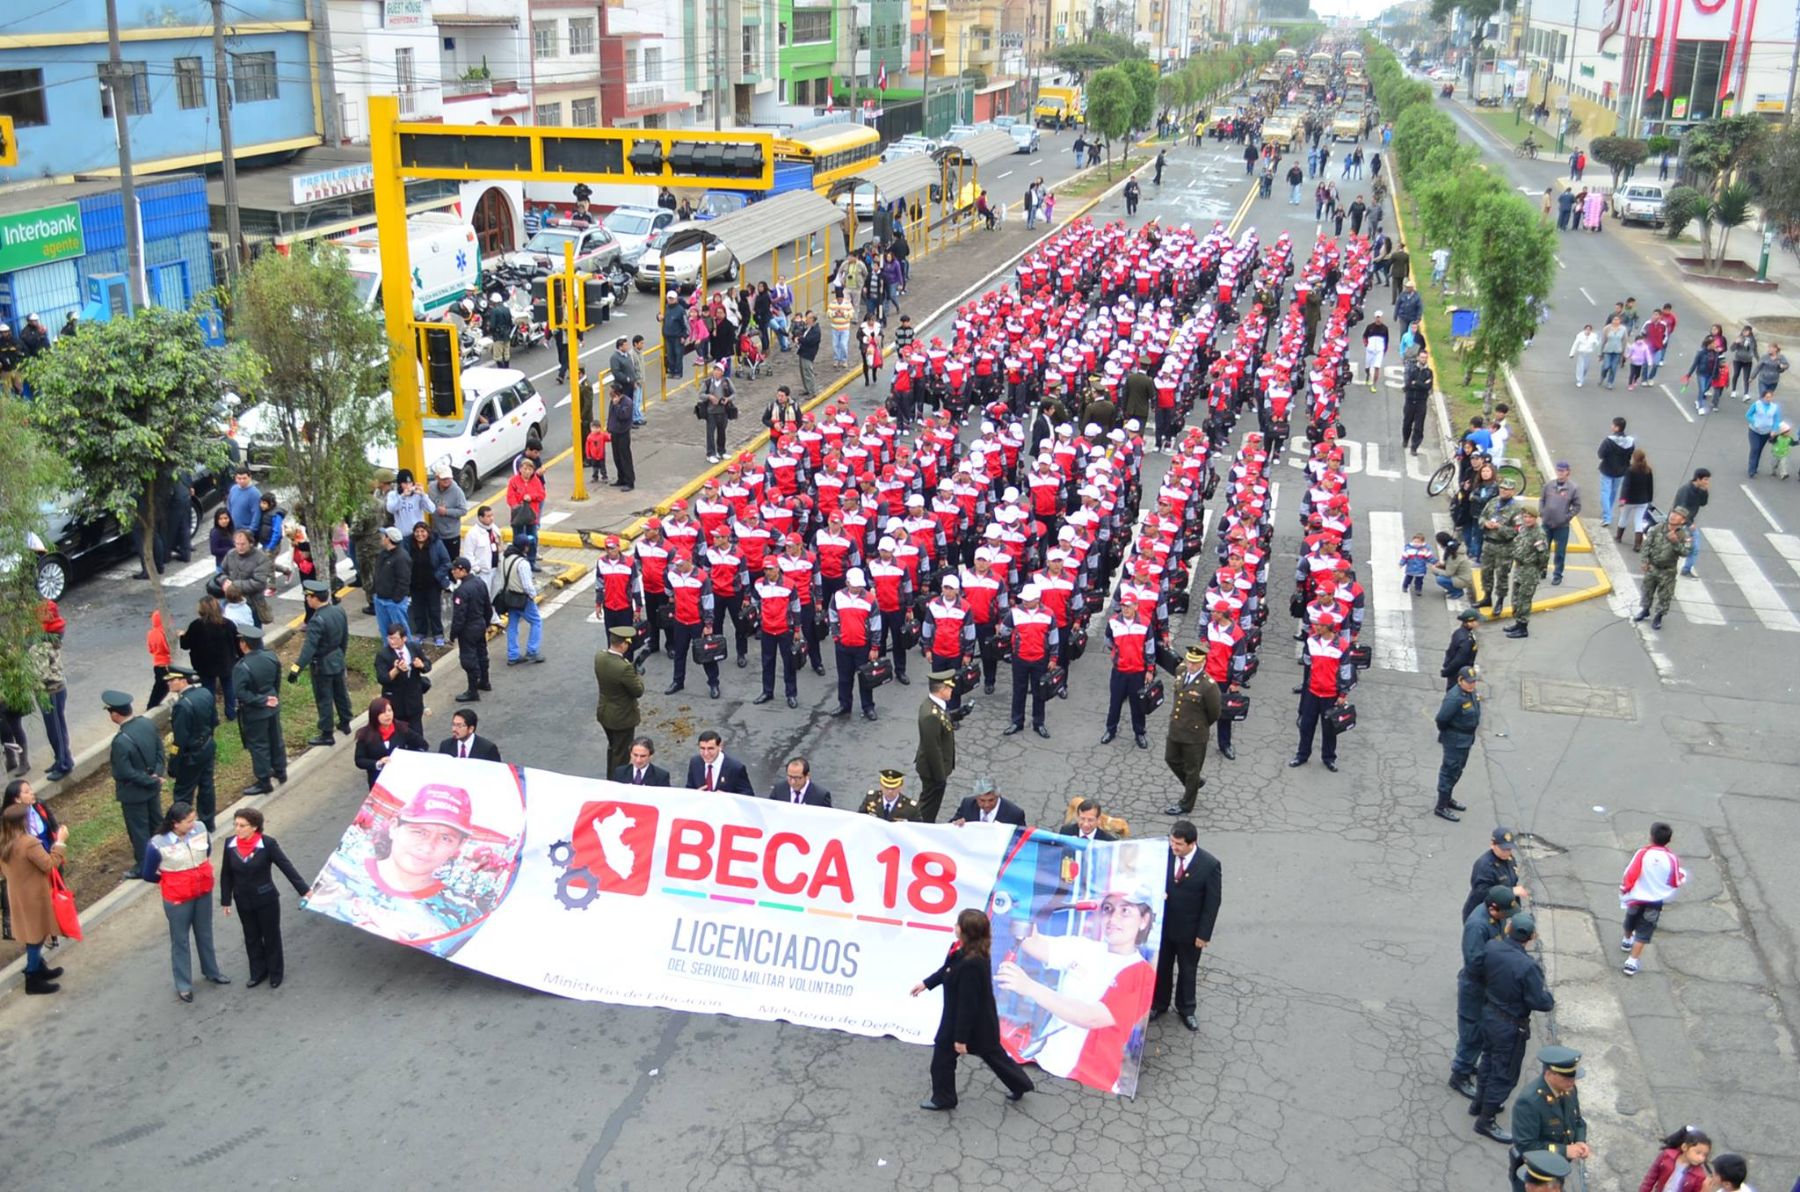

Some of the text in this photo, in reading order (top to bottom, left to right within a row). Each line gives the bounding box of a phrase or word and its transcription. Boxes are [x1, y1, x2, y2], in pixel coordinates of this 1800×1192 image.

[386, 1, 404, 14] GUEST
[4, 213, 77, 246] Interbank
[43, 237, 80, 258] agente
[665, 817, 958, 914] BECA 18
[671, 917, 861, 978] LICENCIADOS
[667, 957, 854, 997] DEL SERVICIO MILITAR VOLUNTARIO
[838, 1014, 858, 1027] de
